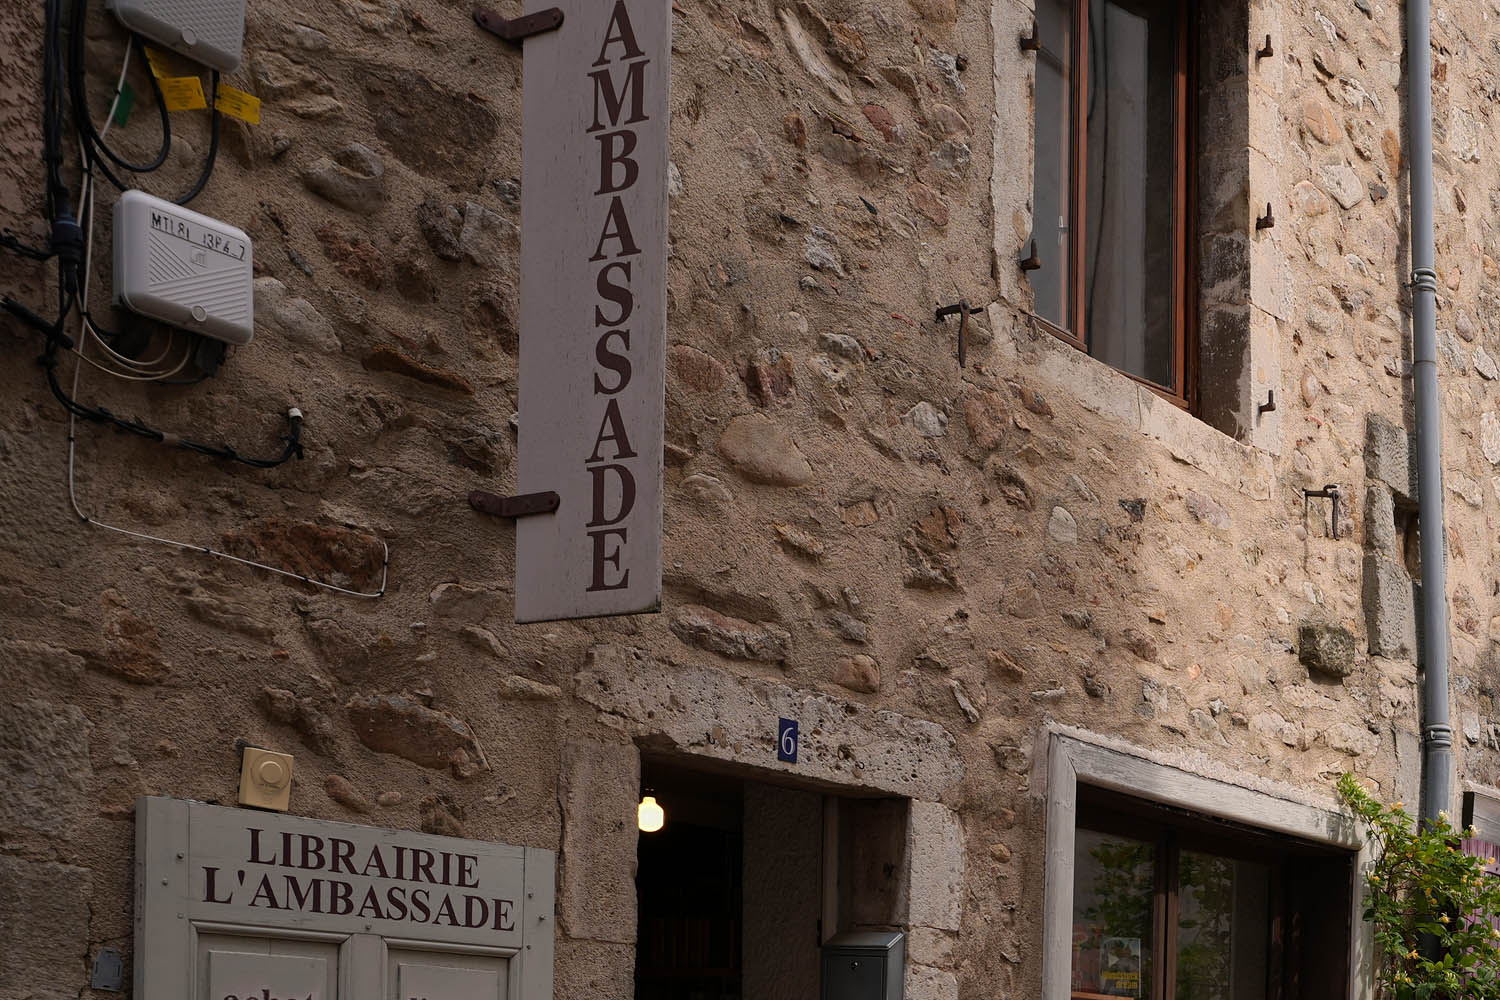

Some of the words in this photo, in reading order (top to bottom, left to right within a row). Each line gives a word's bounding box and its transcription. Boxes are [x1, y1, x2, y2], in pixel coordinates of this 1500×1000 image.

[586, 0, 650, 592] AMBASSADE
[782, 727, 795, 755] 6
[246, 828, 479, 888] LIBRAIRIE
[202, 866, 516, 931] L'AMBASSADE
